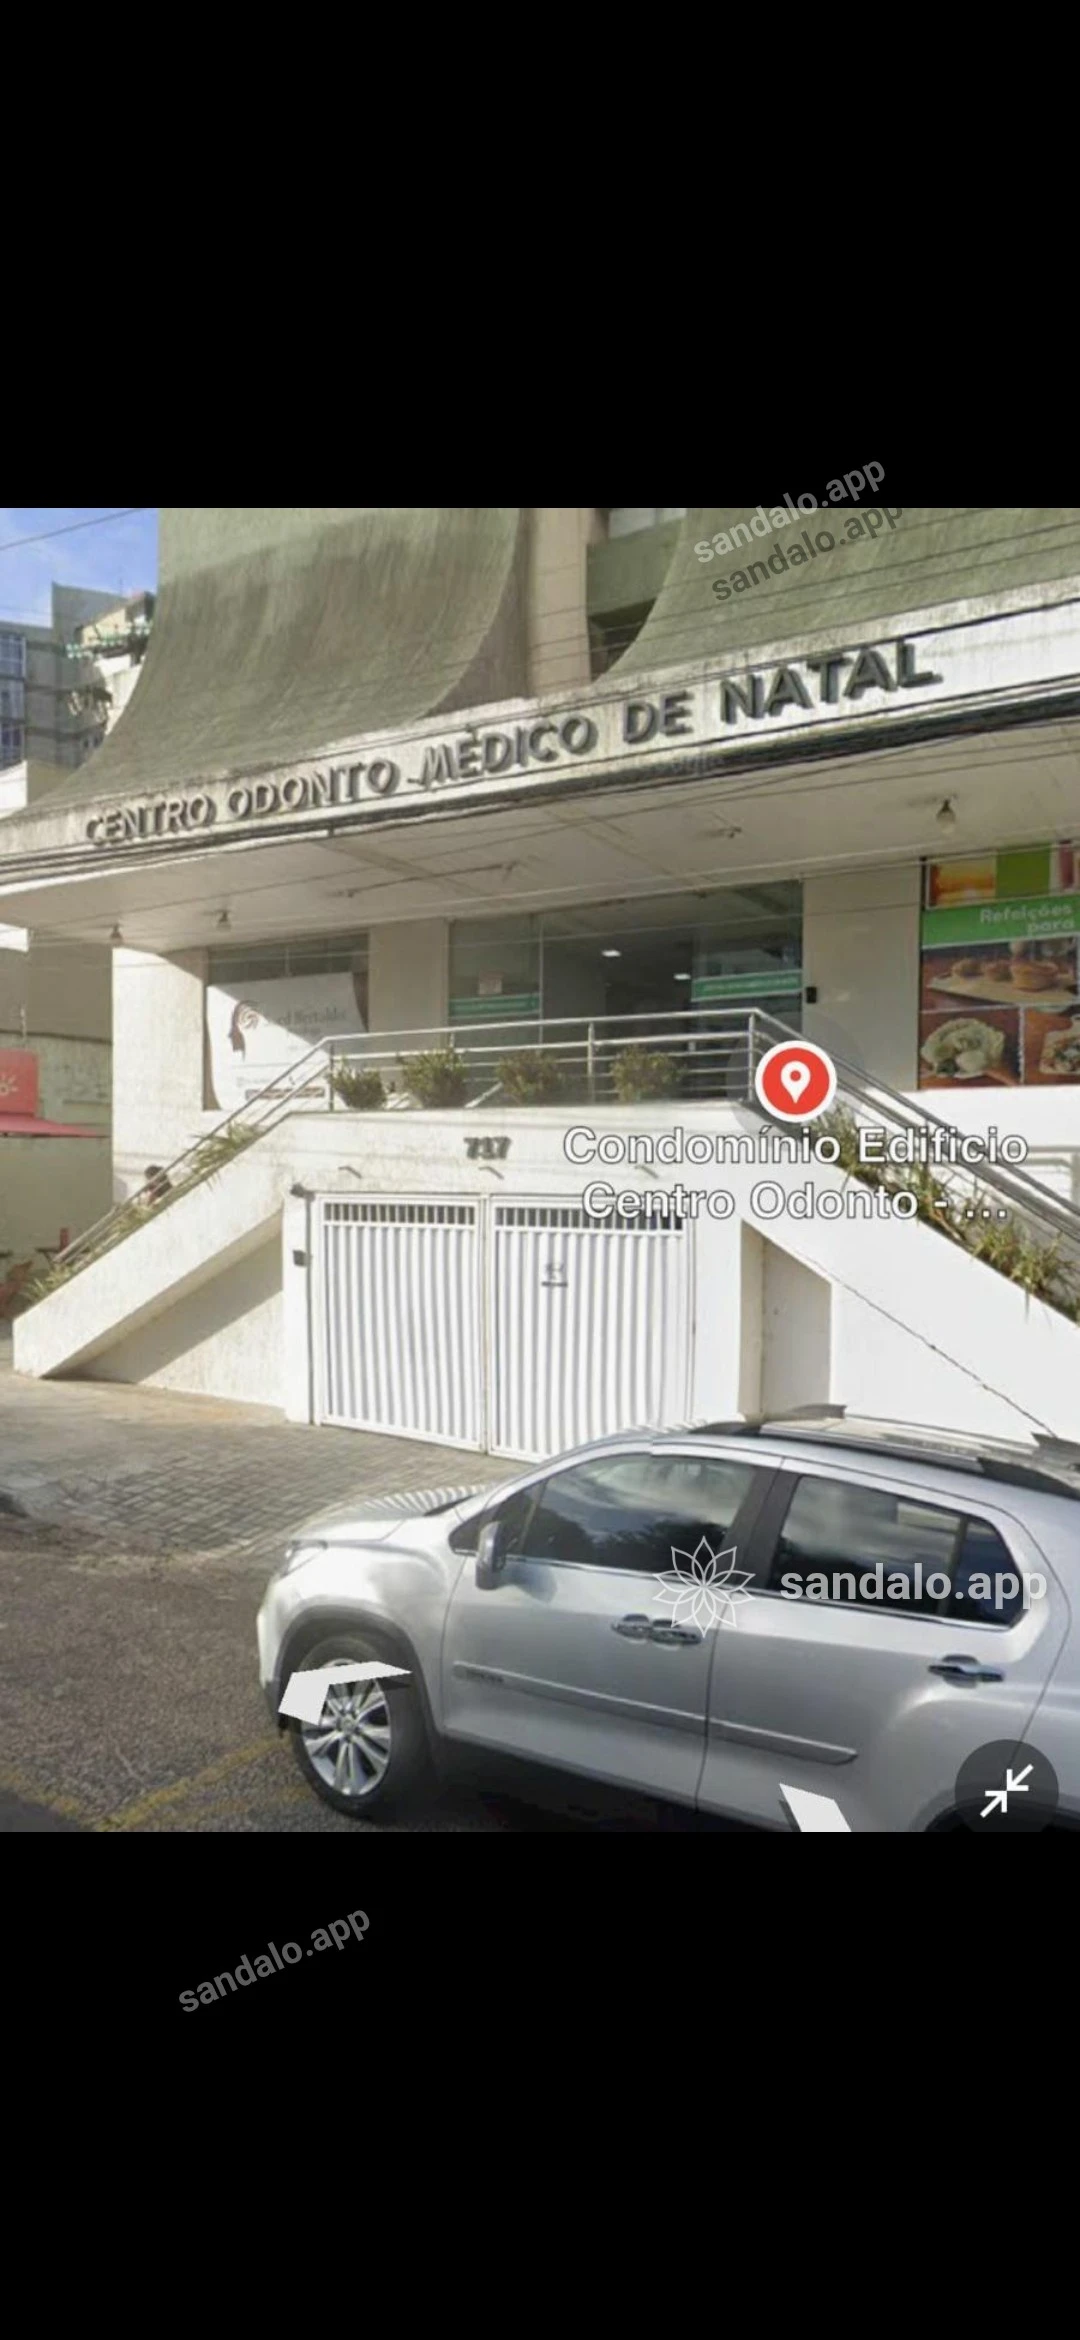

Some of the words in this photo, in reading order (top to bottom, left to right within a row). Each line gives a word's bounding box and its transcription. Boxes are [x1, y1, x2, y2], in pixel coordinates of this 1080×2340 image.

[86, 793, 218, 847] CENTRO
[228, 757, 401, 818] ODONTO
[621, 690, 695, 746] DE
[720, 640, 943, 724] NATAL
